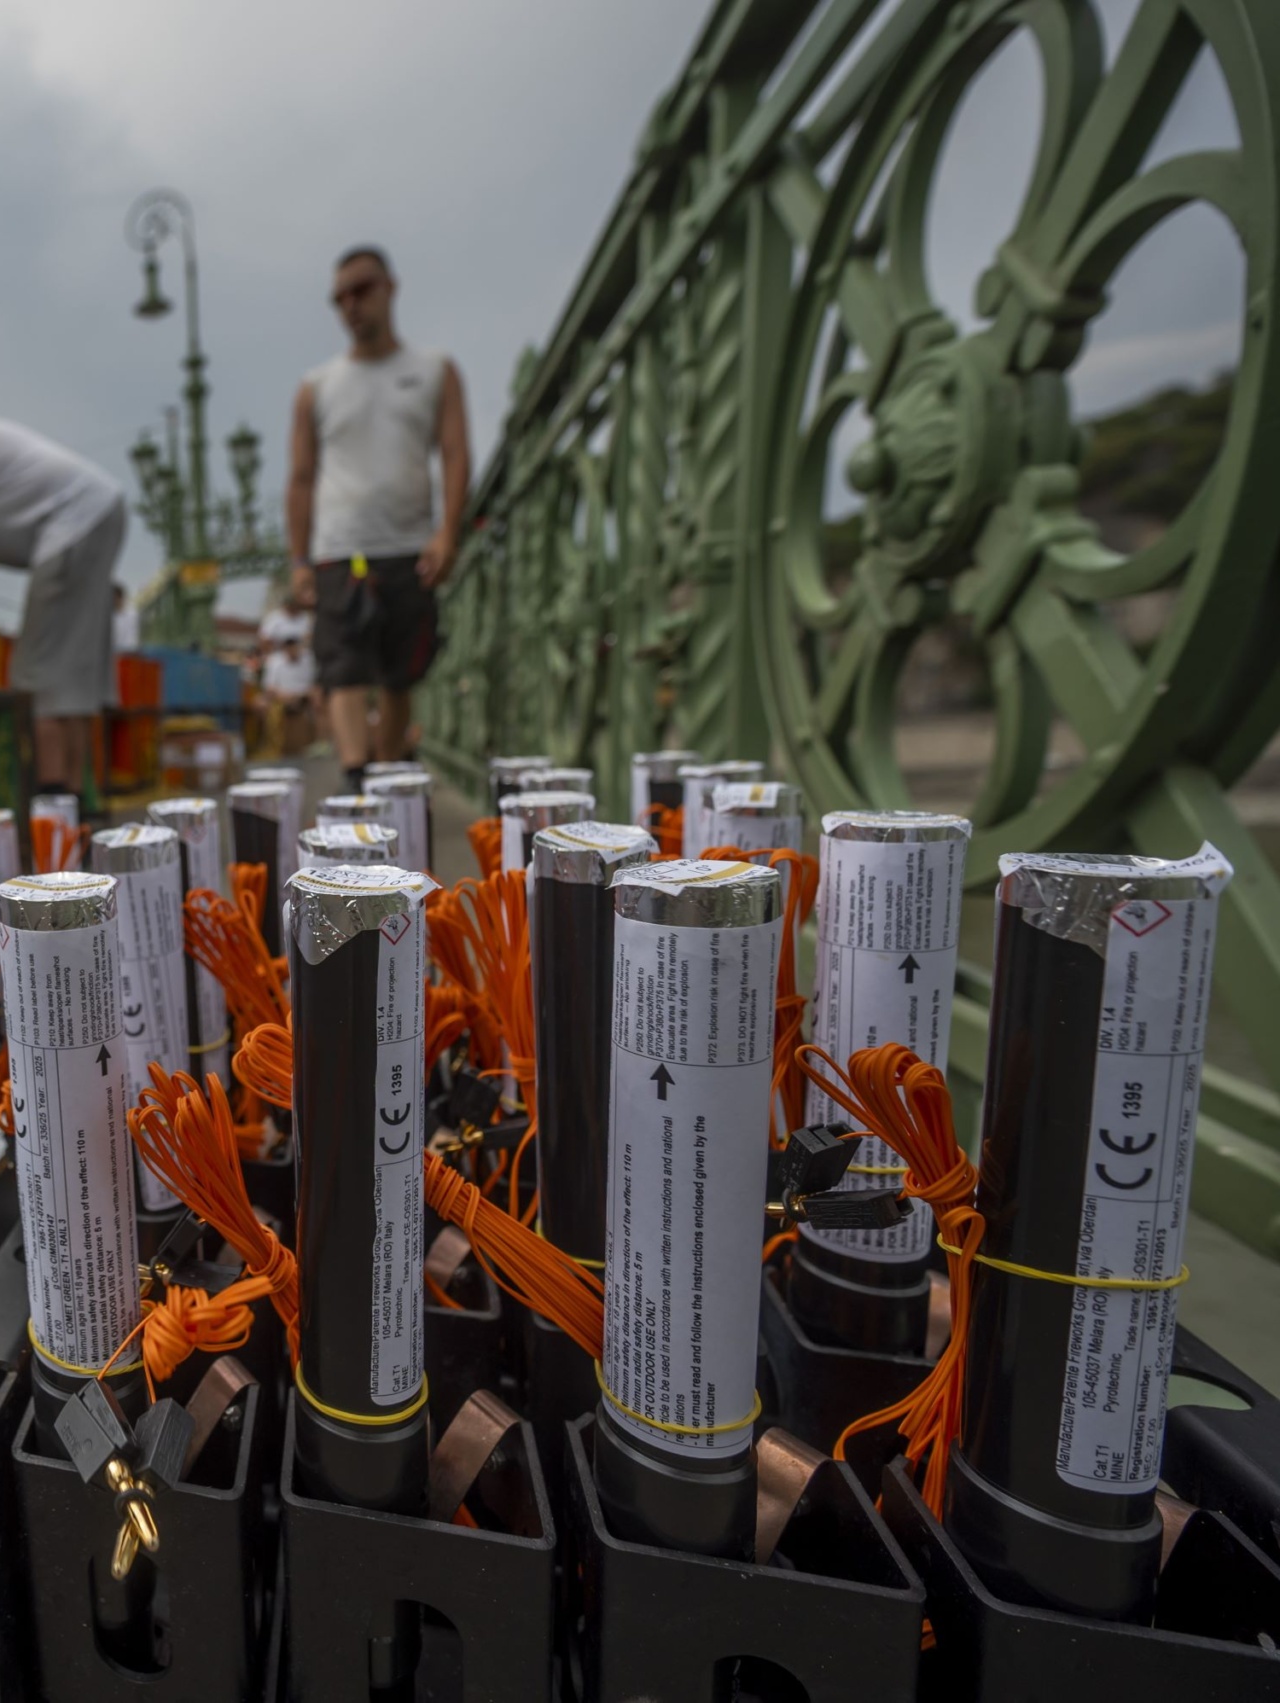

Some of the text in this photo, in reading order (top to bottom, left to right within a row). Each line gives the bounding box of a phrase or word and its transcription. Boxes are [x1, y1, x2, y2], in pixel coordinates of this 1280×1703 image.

[679, 1023, 687, 1035] the
[1103, 1007, 1115, 1022] 1.4
[1100, 1026, 1113, 1048] DIV.
[35, 1055, 43, 1076] 2025
[391, 1064, 402, 1095] 1395
[1121, 1081, 1142, 1119] 1395
[379, 1102, 411, 1154] CE
[662, 1116, 671, 1154] national
[694, 1115, 703, 1132] the
[662, 1157, 671, 1175] and
[693, 1150, 705, 1179] given
[1093, 1127, 1157, 1192] CE
[80, 1185, 88, 1199] the
[661, 1178, 671, 1231] instructions
[693, 1181, 702, 1228] enclosed
[59, 1226, 67, 1246] RAIL
[82, 1212, 91, 1249] direction
[105, 1250, 113, 1272] ONLY
[372, 1236, 381, 1262] Group
[622, 1238, 630, 1281] direction
[661, 1234, 670, 1264] written
[692, 1230, 702, 1290] instructions
[75, 1258, 83, 1279] years
[85, 1261, 94, 1297] distance
[382, 1221, 394, 1338] 105-45037 Melara (RO) Italy
[661, 1267, 670, 1286] with
[62, 1271, 71, 1301] GREEN
[97, 1273, 106, 1298] safety
[372, 1265, 380, 1305] Fireworks
[1074, 1285, 1087, 1312] Grou
[87, 1299, 97, 1323] safety
[98, 1300, 106, 1323] radial
[108, 1294, 117, 1337] OUTDOOR
[394, 1287, 403, 1337] Pyrotechnic
[660, 1288, 670, 1341] accordance
[691, 1293, 701, 1309] the
[64, 1303, 73, 1334] COMET
[691, 1312, 700, 1342] follow
[78, 1328, 87, 1362] Minimum
[89, 1325, 98, 1361] Minimum
[100, 1325, 108, 1360] Minimun
[621, 1337, 630, 1366] safety
[1082, 1291, 1110, 1408] 105-45037 Melara (RO)
[1124, 1325, 1137, 1350] Trade
[645, 1297, 655, 1419] OR OUTDOOR USE ONLY
[660, 1354, 669, 1376] used
[690, 1344, 700, 1363] and
[690, 1366, 700, 1387] read
[1103, 1352, 1125, 1412] Pyrotechnic
[690, 1390, 699, 1414] must
[1129, 1364, 1150, 1480] Registration Number:
[1094, 1444, 1109, 1477] Cat.T1
[1111, 1451, 1124, 1479] MINE
